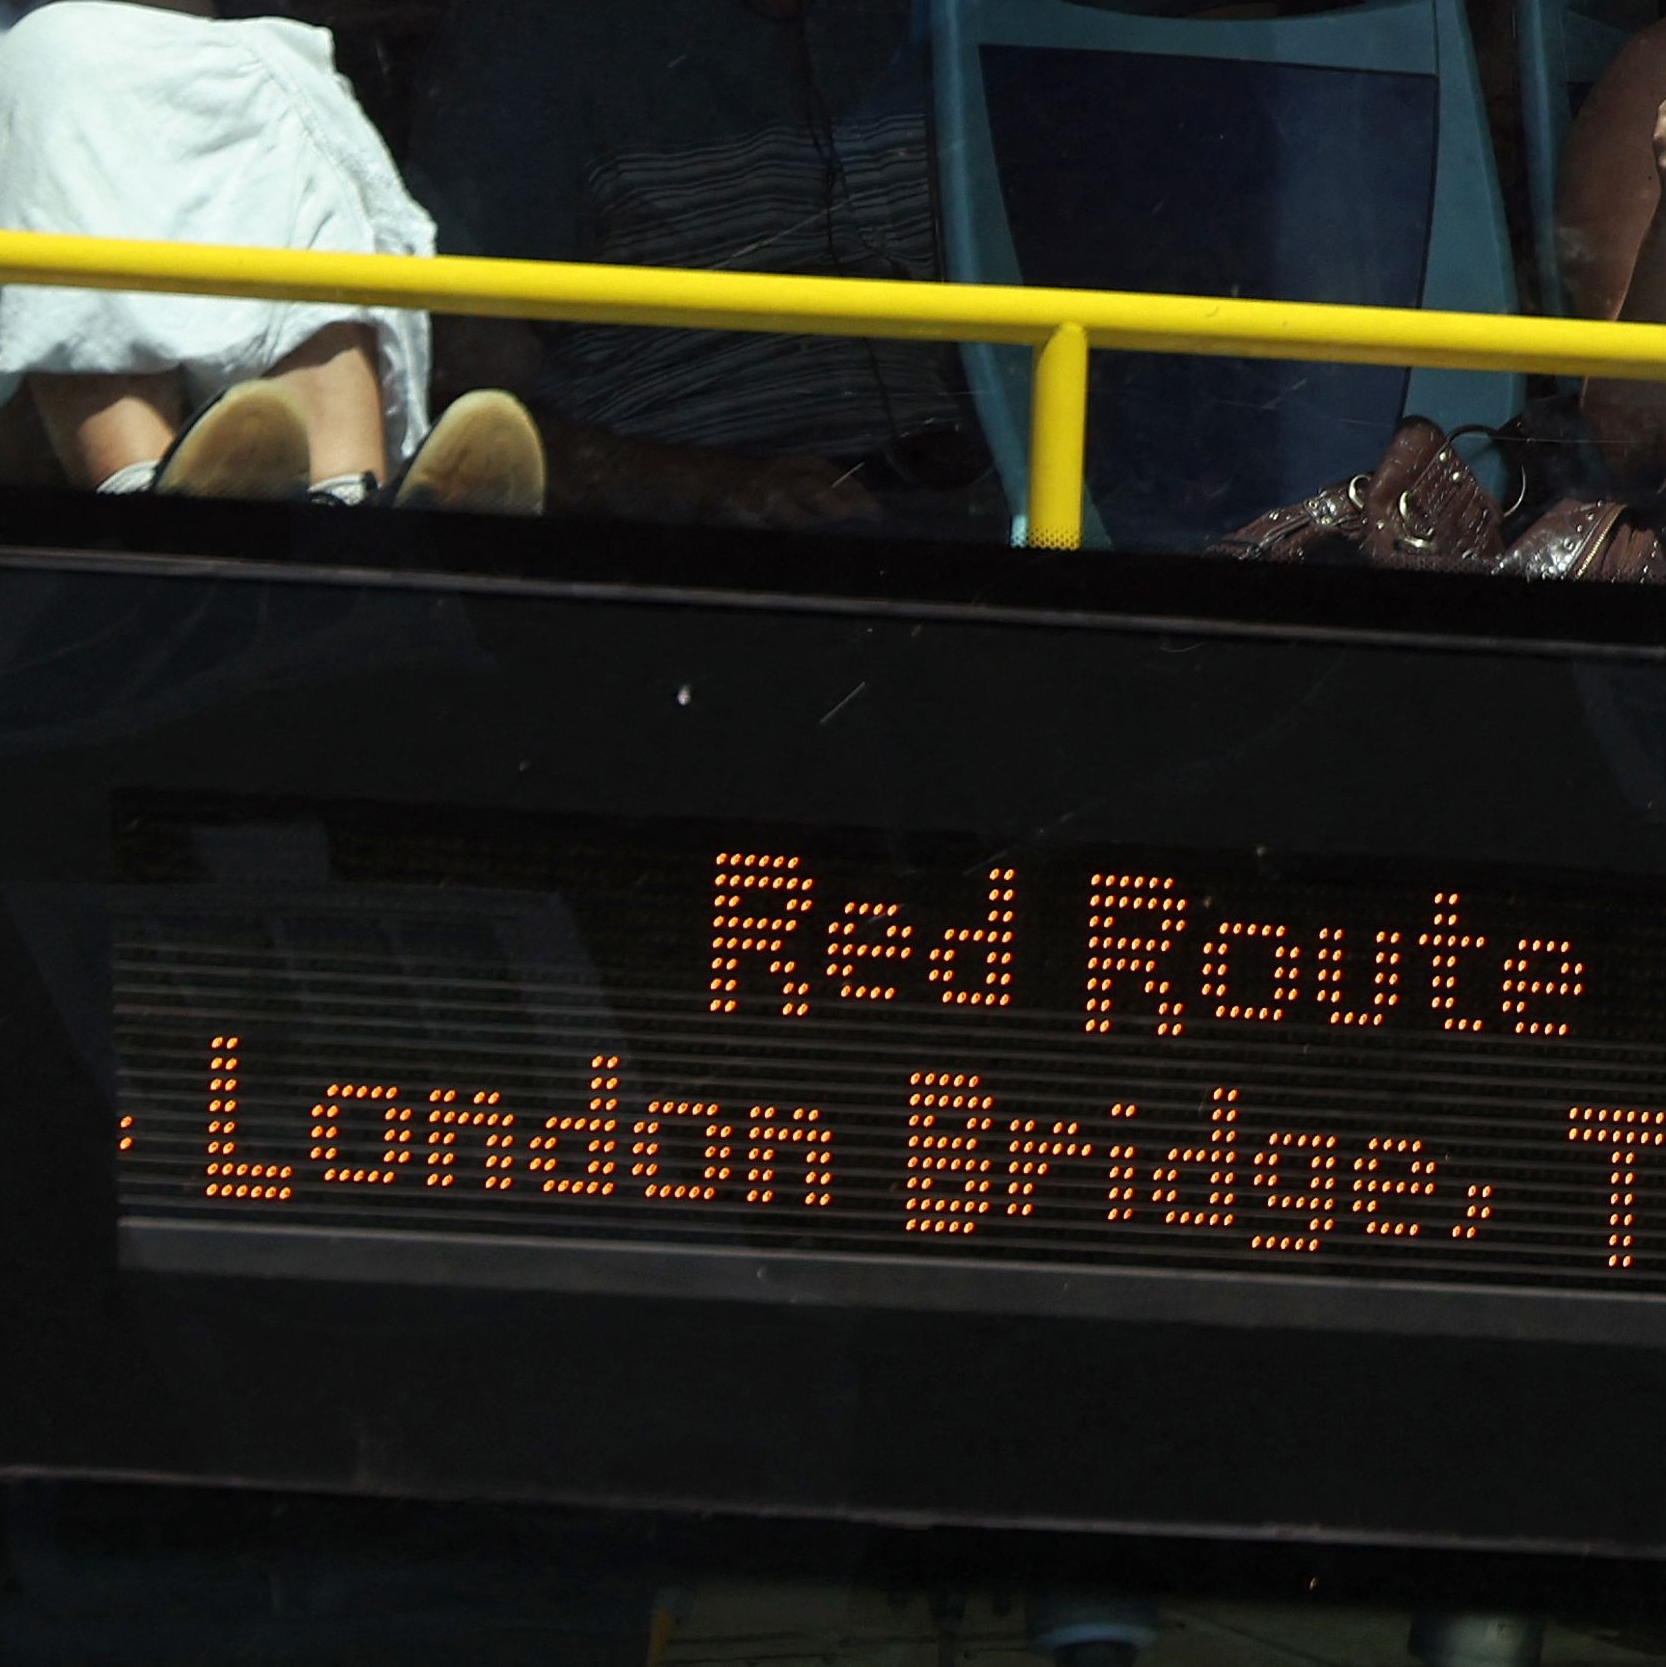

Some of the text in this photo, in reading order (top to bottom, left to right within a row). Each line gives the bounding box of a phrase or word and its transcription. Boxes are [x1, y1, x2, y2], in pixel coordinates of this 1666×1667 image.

[709, 852, 1583, 1036] Red Route
[205, 1036, 831, 1206] London
[905, 1072, 1492, 1252] Bridge,
